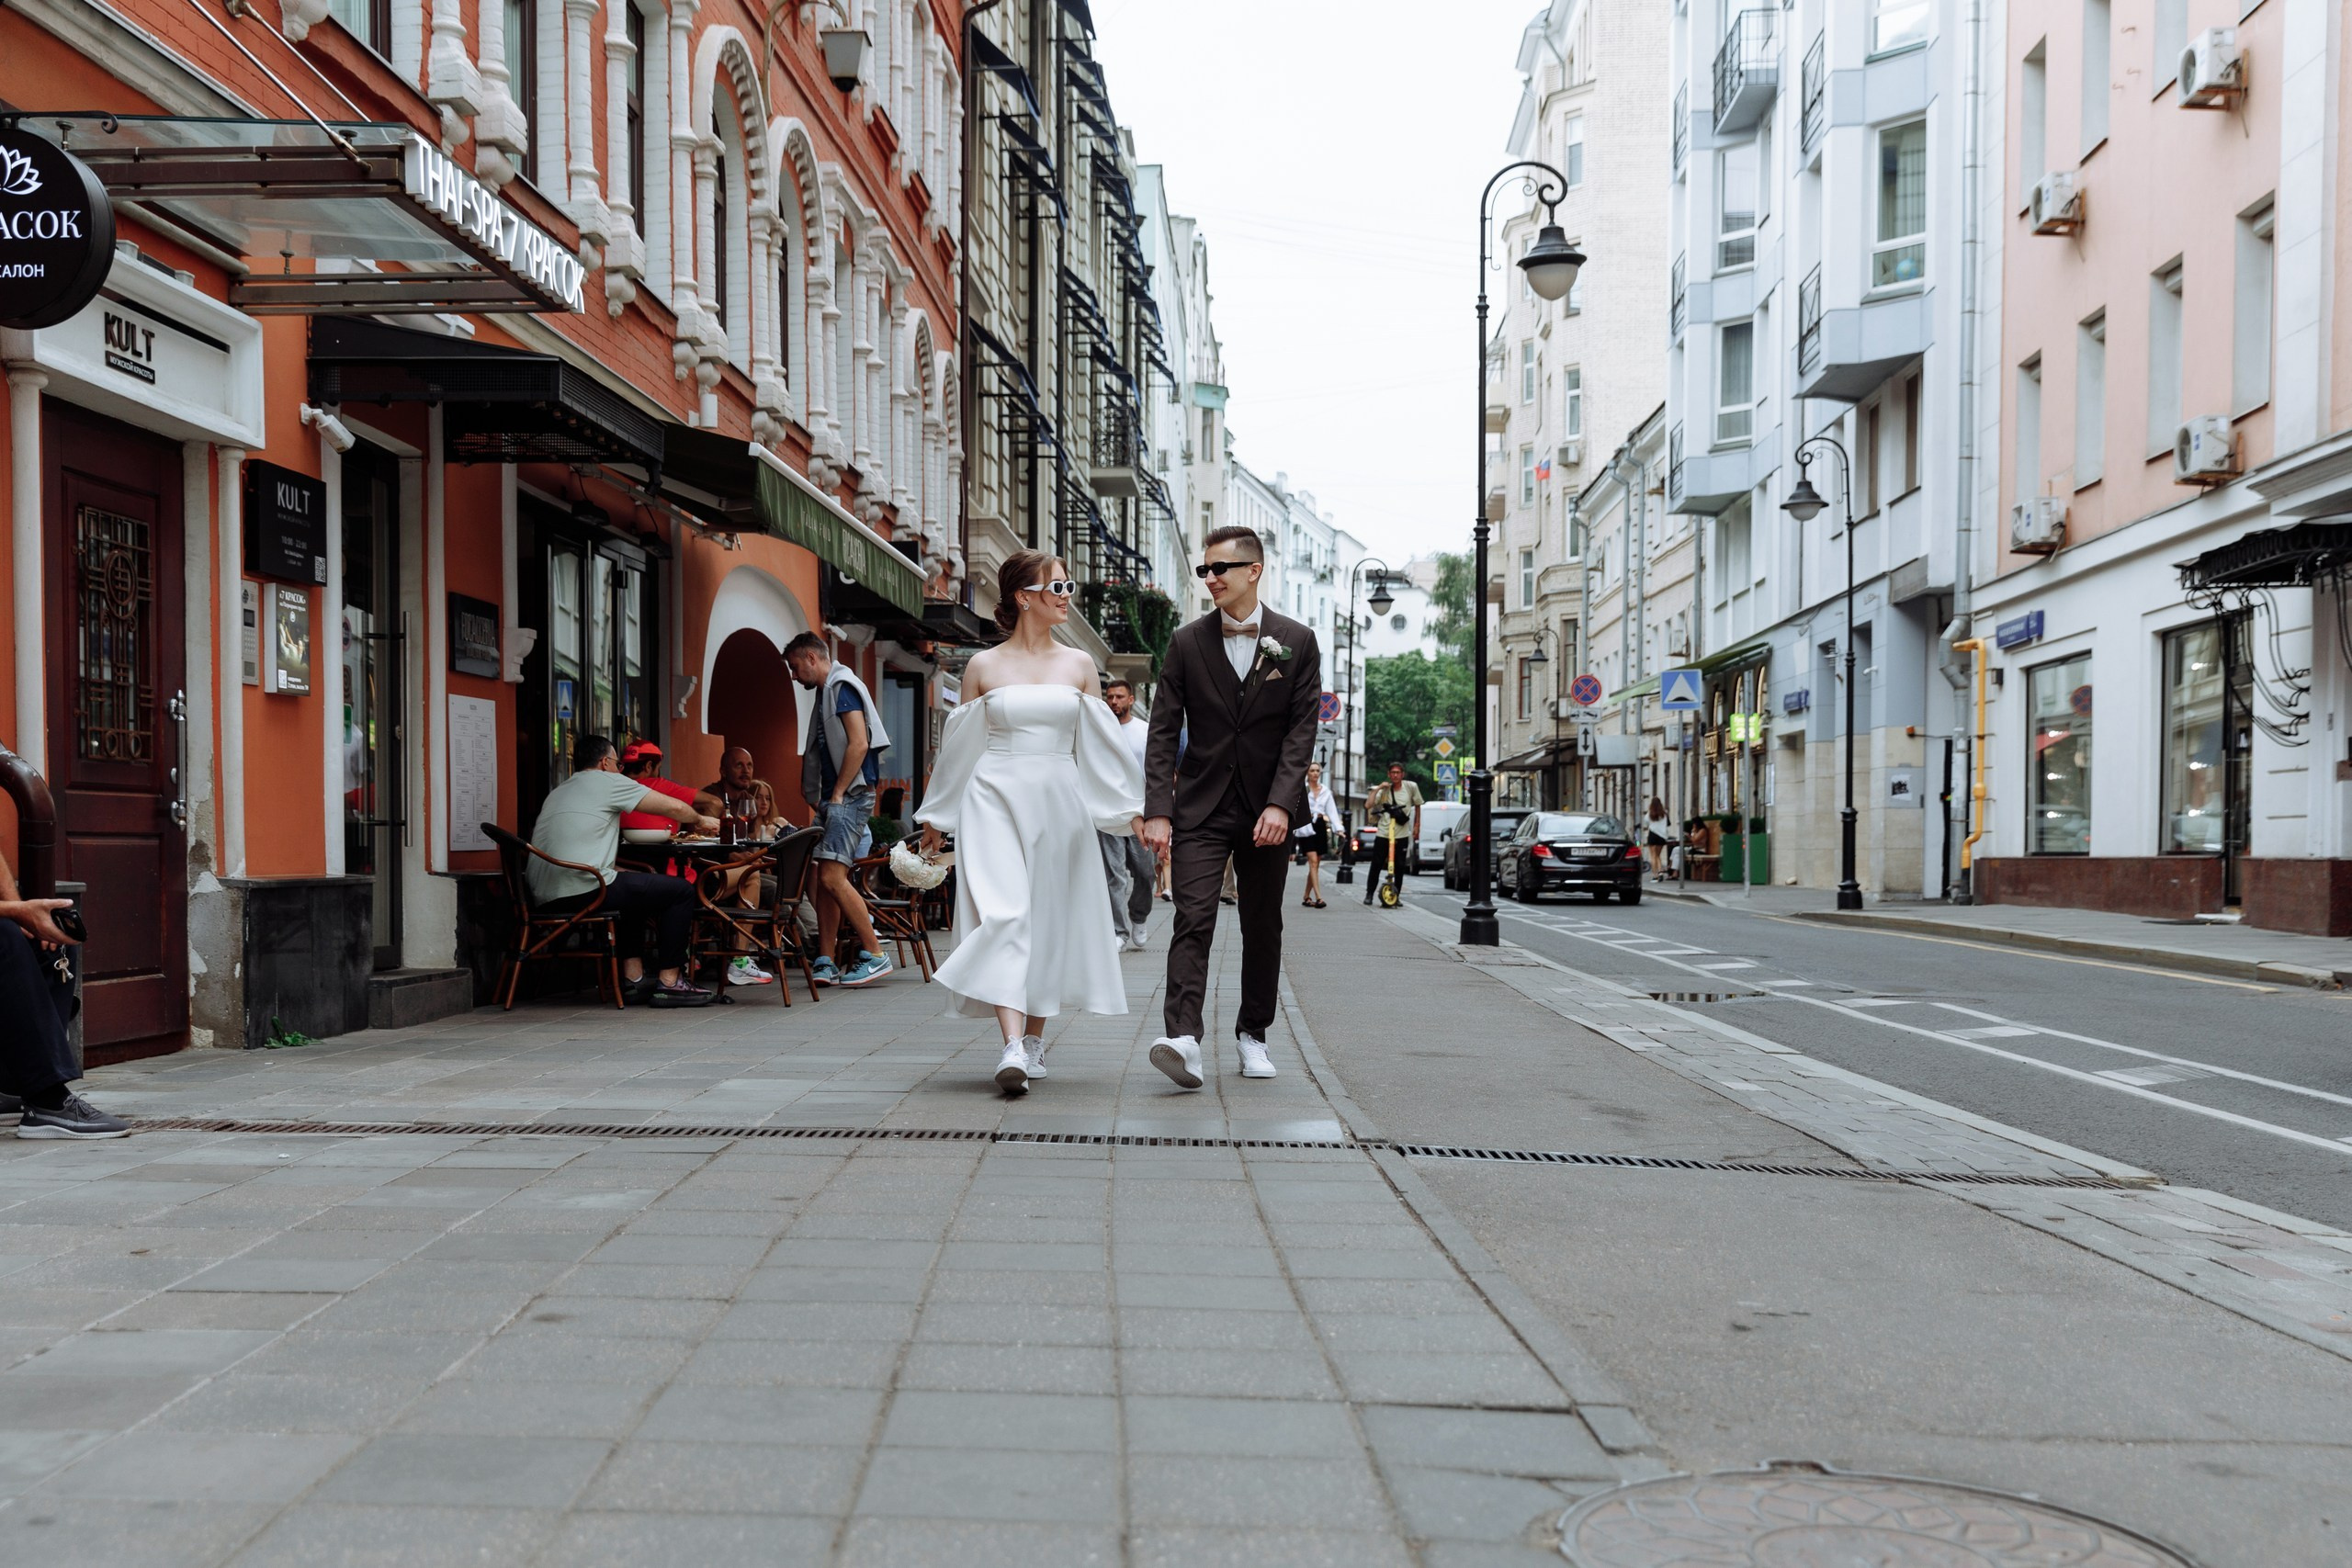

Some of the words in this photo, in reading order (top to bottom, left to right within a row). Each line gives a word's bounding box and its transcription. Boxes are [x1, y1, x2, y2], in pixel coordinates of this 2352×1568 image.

[410, 133, 504, 257] THAI-SPA
[522, 220, 585, 314] КРАСОК
[0, 264, 44, 277] АЛОН
[105, 311, 155, 362] KULT
[277, 481, 311, 514] KULT
